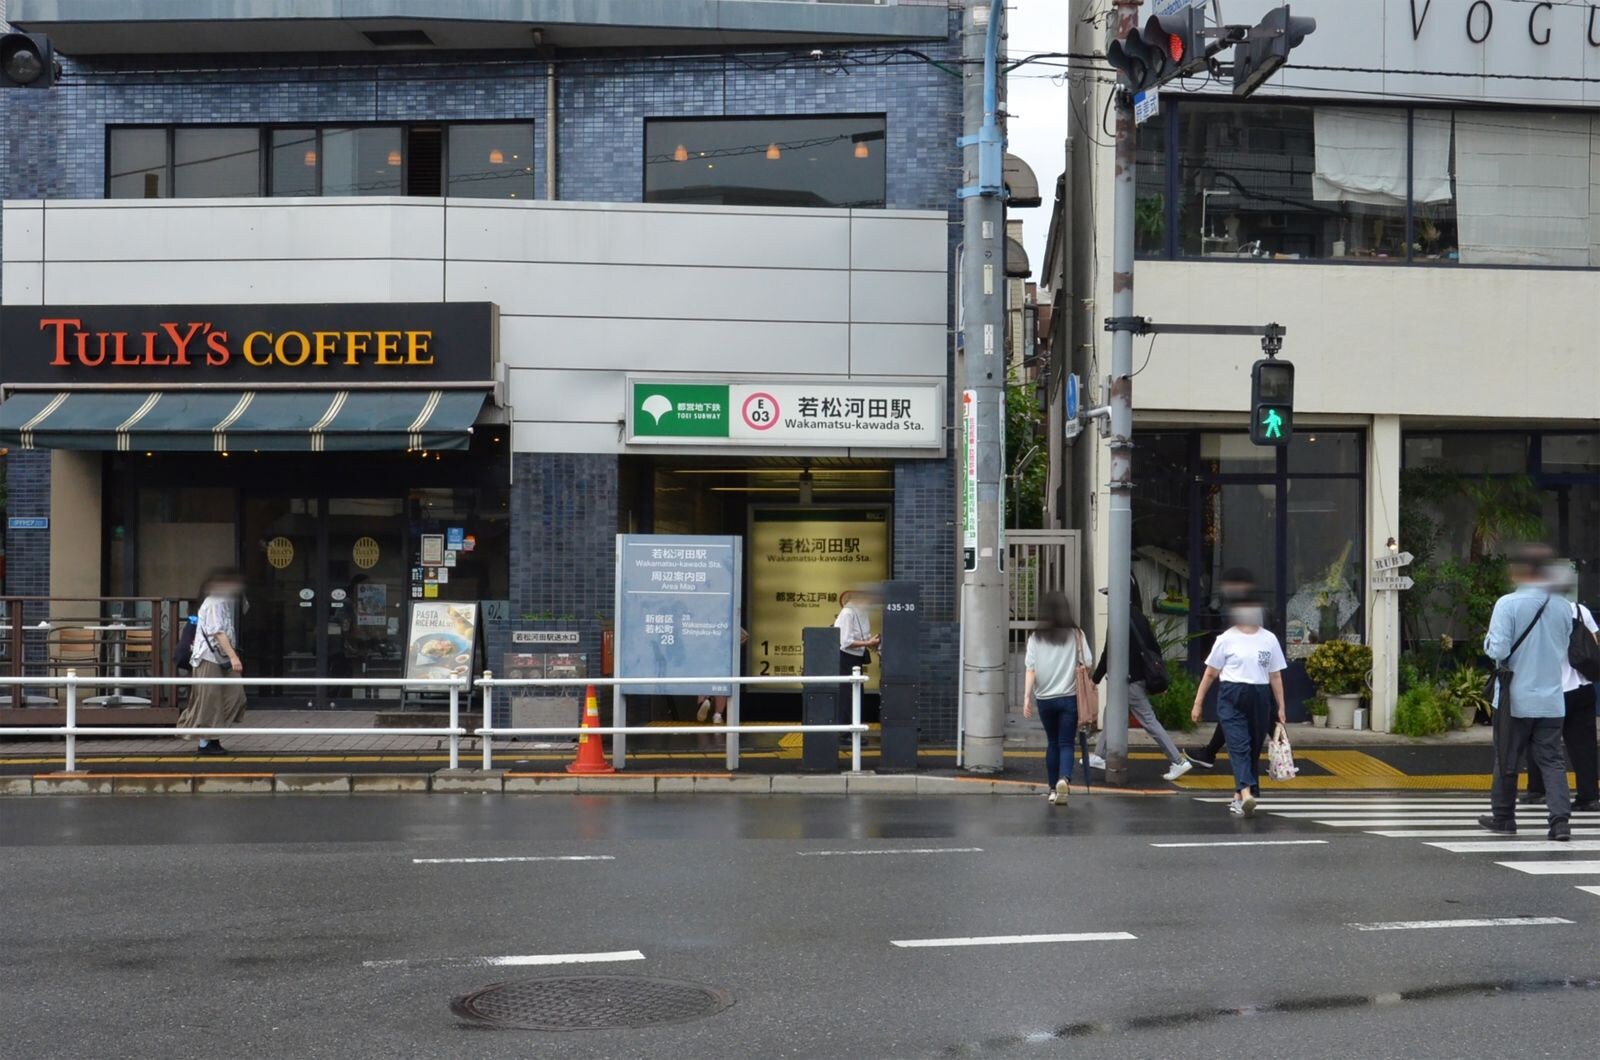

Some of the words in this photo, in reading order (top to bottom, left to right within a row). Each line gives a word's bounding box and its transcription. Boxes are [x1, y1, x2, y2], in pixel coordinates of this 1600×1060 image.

[242, 330, 434, 366] COFFEE
[677, 402, 721, 412] 都営地下鉄
[757, 399, 764, 409] E
[798, 397, 911, 419] 若松河田駅
[752, 411, 770, 422] 03
[785, 419, 900, 430] Wakamatsu-kawada
[903, 420, 924, 431] Sta.
[779, 538, 860, 553] 若松河田駅
[651, 549, 706, 560] 若松河田駅
[767, 554, 853, 562] Wakamatsu-kawada
[856, 554, 872, 562] Sta.
[635, 560, 707, 568] Wakamatsu-kawada
[708, 560, 722, 568] Sta.
[1375, 554, 1405, 569] RUBY
[651, 571, 706, 582] 周辺案内図
[680, 583, 696, 591] Map
[776, 591, 837, 602] 都営大江戸線
[416, 610, 438, 619] PASTA
[646, 614, 673, 624] 新宿区
[415, 619, 428, 627] RICE
[430, 619, 446, 627] MEAL
[646, 624, 673, 634] 若松町
[516, 633, 577, 642] 若松河田駅送水口
[661, 634, 674, 645] 28
[761, 640, 769, 656] 1
[760, 661, 770, 676] 2
